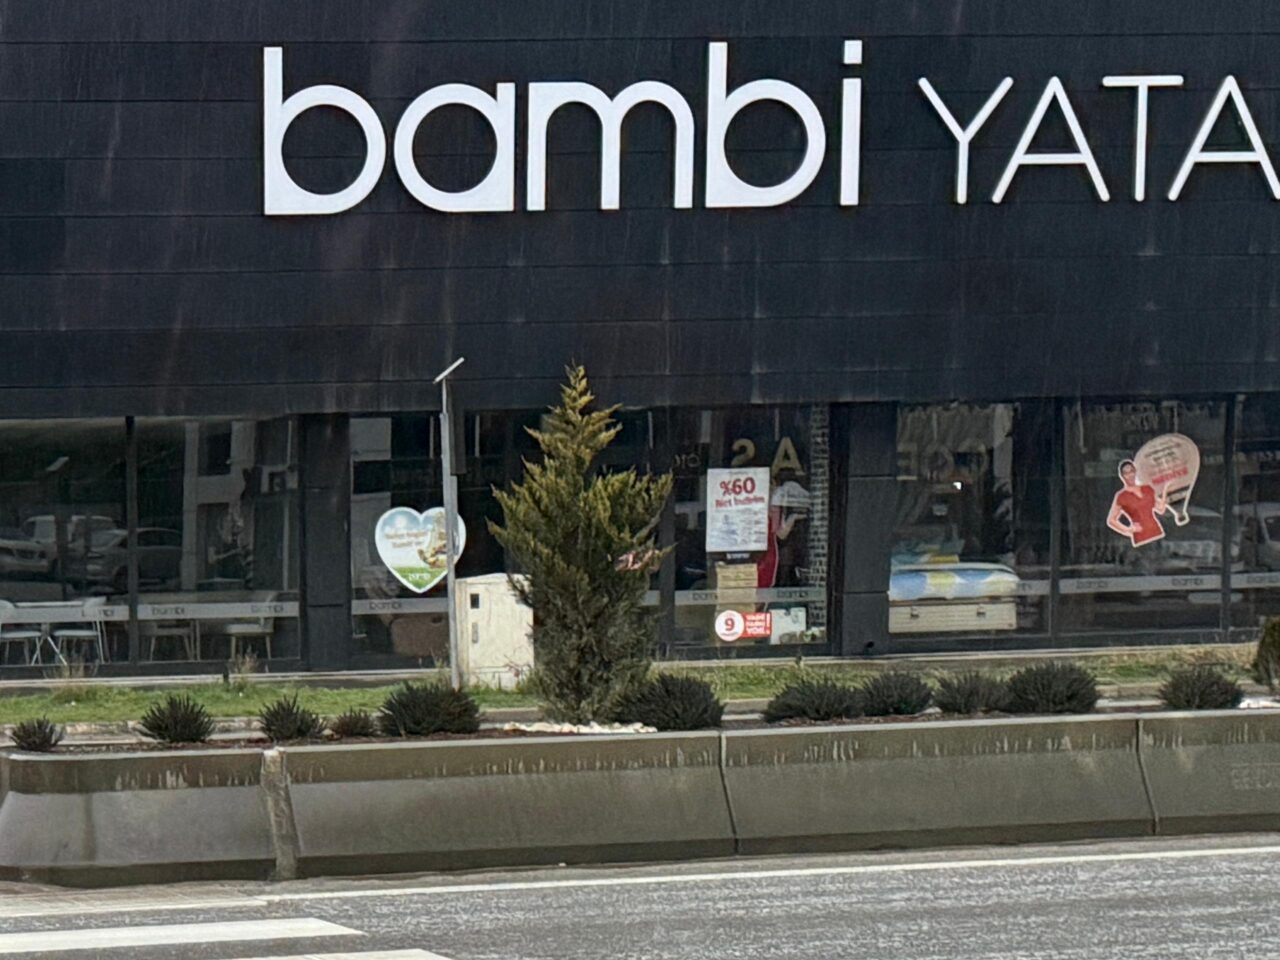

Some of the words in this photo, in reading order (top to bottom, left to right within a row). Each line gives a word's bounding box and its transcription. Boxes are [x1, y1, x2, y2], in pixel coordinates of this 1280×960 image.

[263, 40, 862, 215] bambi
[919, 75, 1280, 204] YATA
[719, 476, 756, 496] %60
[724, 617, 736, 631] 9
